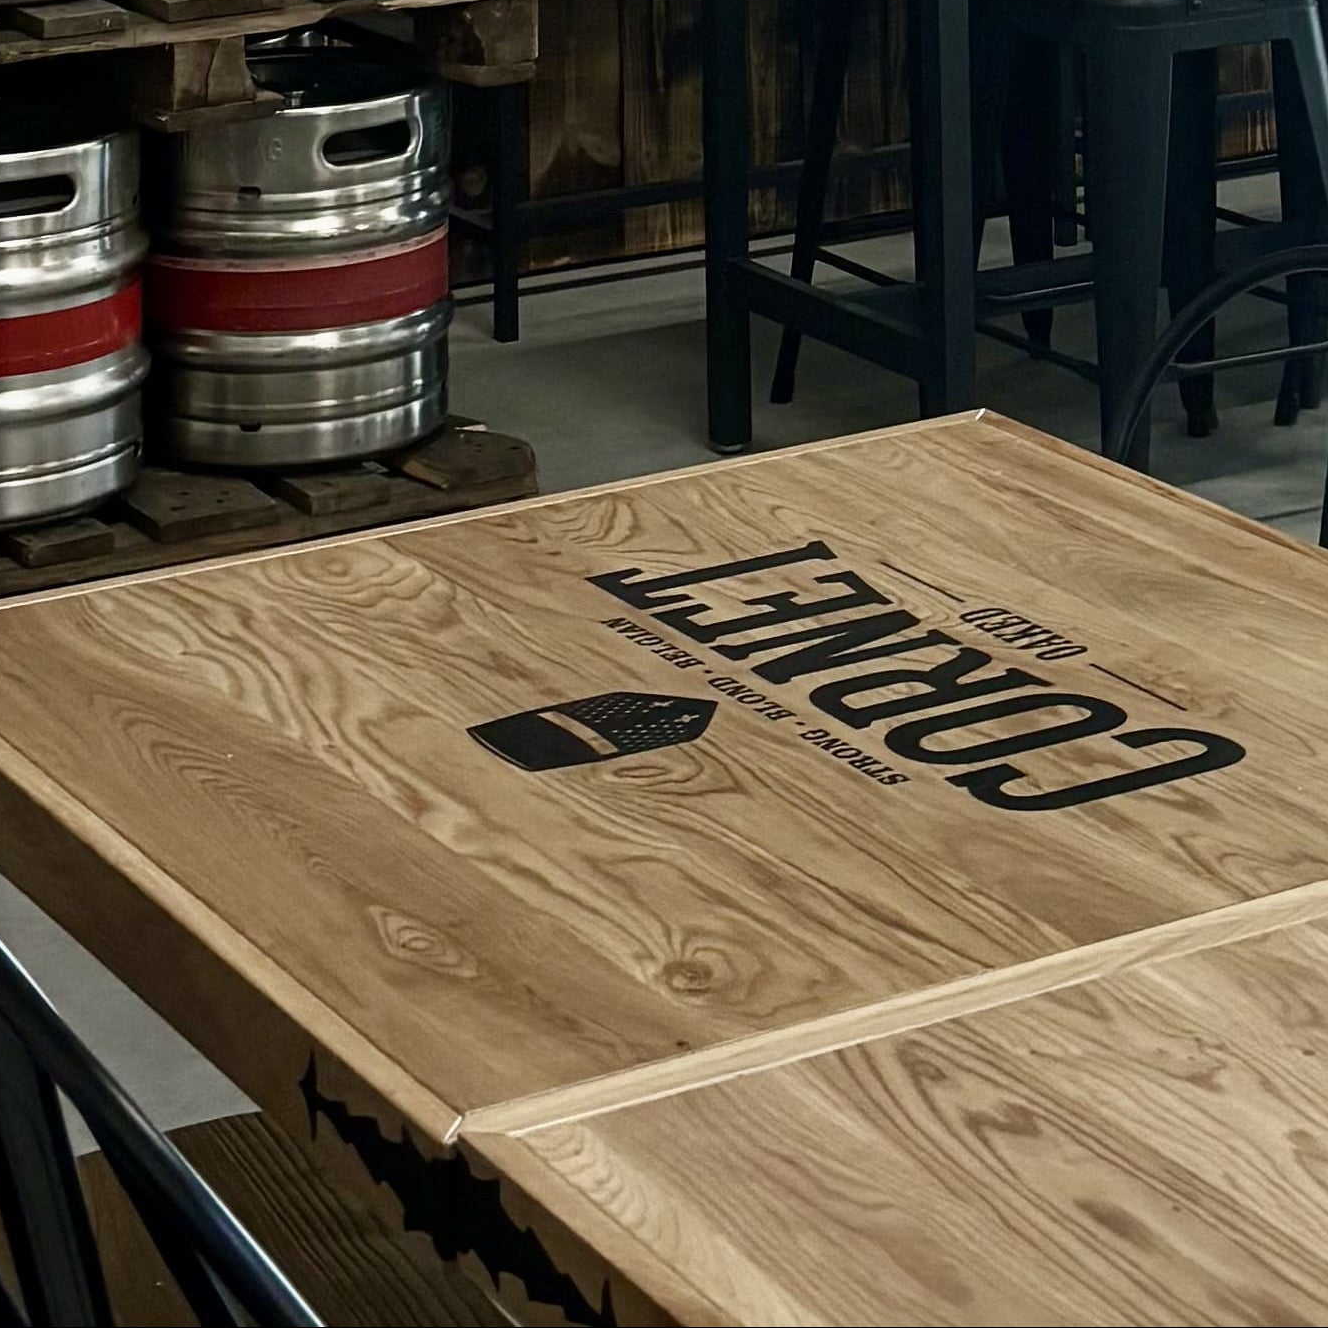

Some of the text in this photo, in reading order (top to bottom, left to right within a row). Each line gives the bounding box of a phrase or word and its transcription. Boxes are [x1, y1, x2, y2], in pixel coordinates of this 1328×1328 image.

[584, 540, 1247, 813] CORNET
[598, 616, 911, 786] STRONG BLOND BELGIAN
[959, 605, 1089, 660] OAKED
